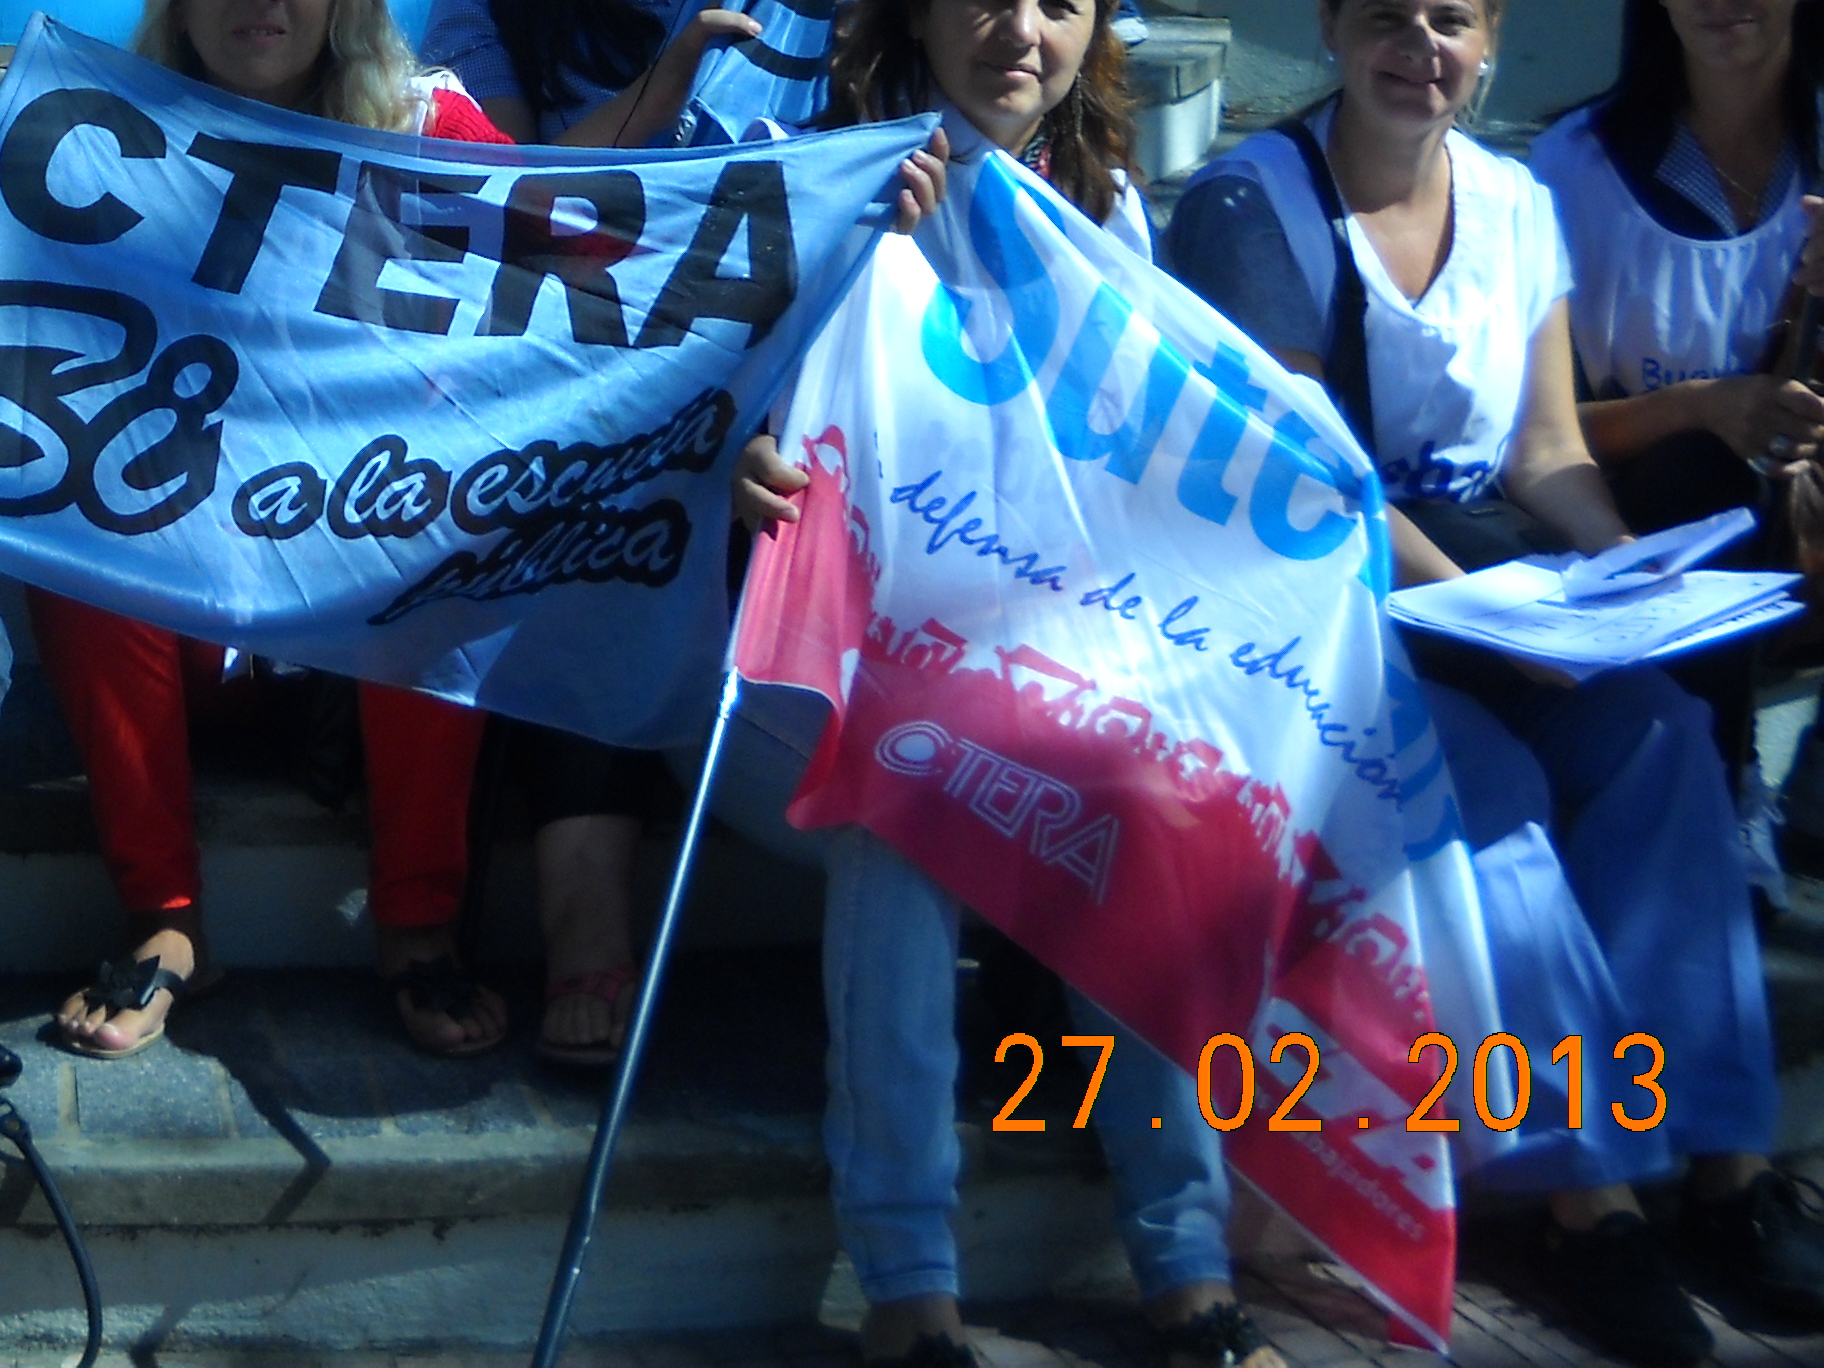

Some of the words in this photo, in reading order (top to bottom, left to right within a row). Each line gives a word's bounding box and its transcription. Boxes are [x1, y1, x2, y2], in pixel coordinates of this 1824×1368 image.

[236, 465, 322, 535] a
[332, 439, 445, 534] la
[889, 470, 1066, 593] defensa
[1082, 572, 1139, 620] de
[1159, 595, 1210, 652] la
[876, 719, 1124, 905] CTERA
